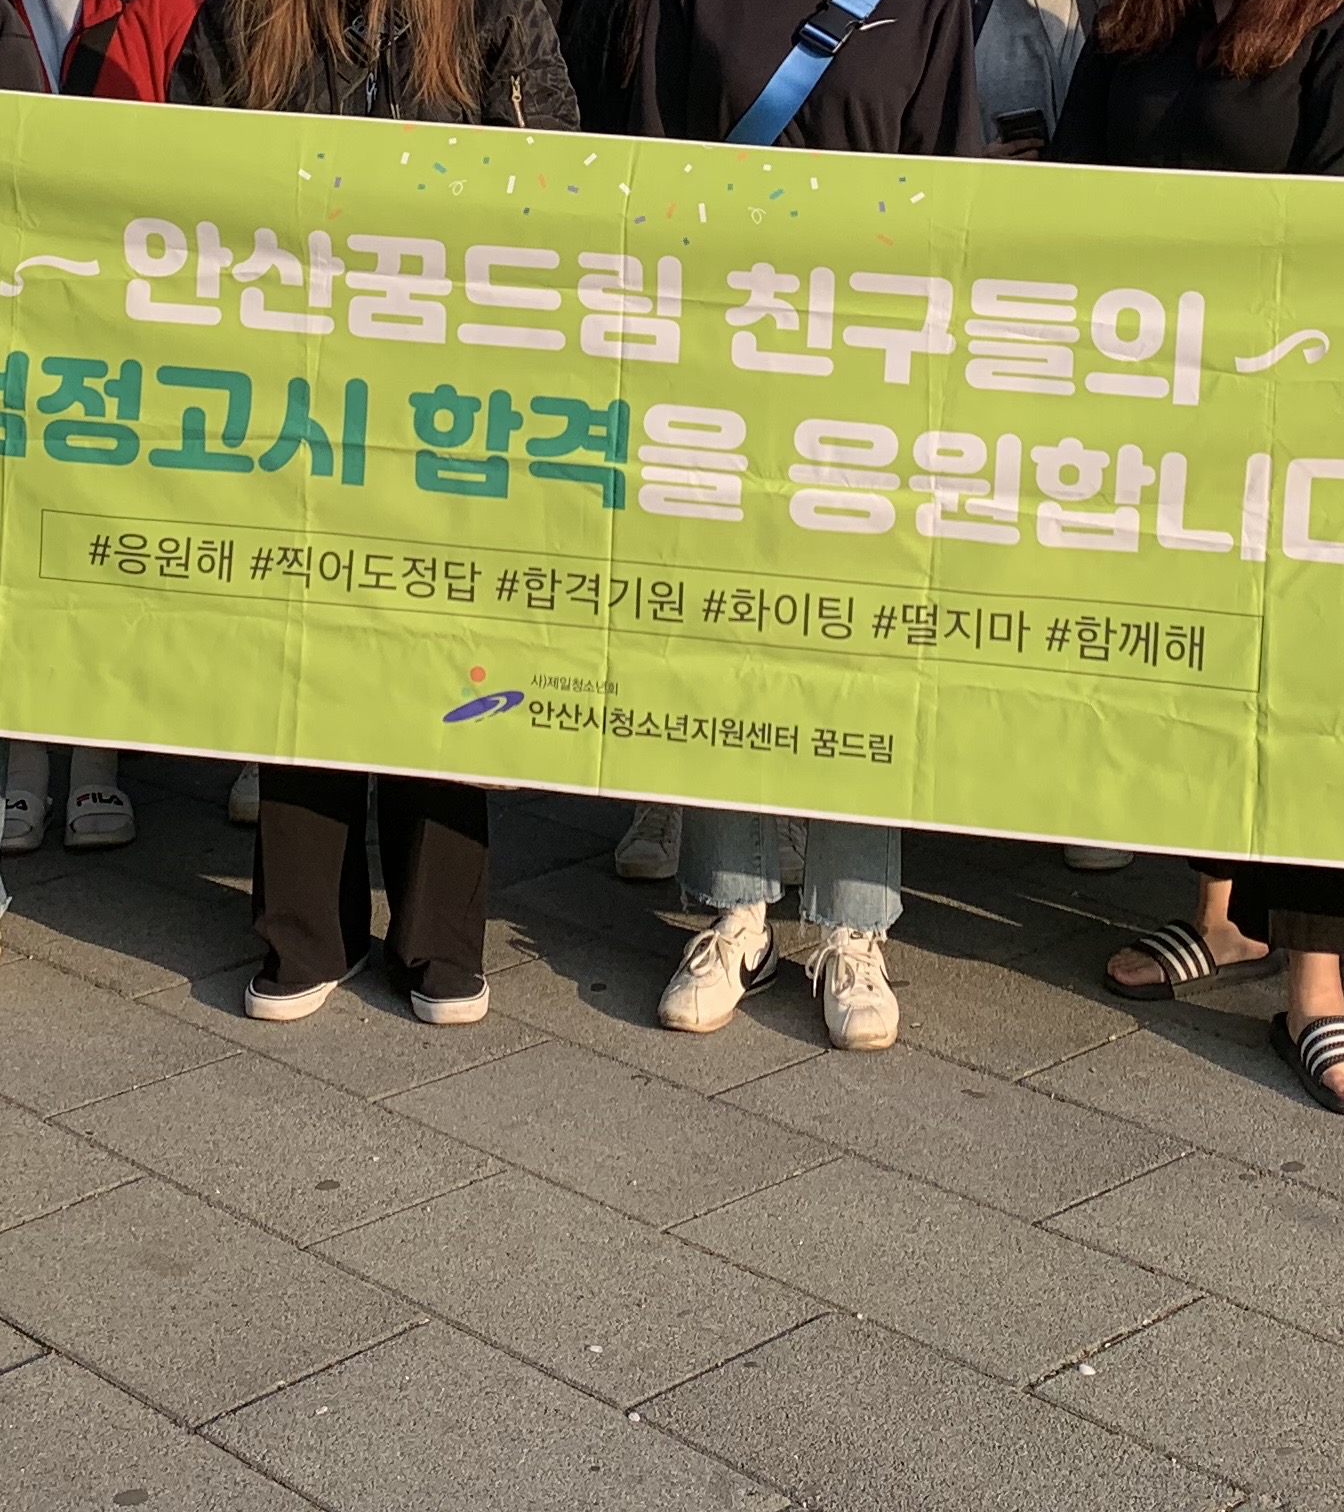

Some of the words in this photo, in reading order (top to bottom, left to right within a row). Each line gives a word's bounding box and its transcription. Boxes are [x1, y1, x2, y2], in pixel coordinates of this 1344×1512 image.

[124, 217, 682, 364] 안산꿈드림
[725, 262, 1205, 406] 친구들의
[409, 384, 749, 522] 합격을
[88, 533, 234, 583] #응원해
[250, 545, 482, 603] #찍어도정답
[496, 567, 684, 623] #합격기원
[702, 587, 854, 640] #화이팅
[871, 604, 1031, 653] #떨지마
[1045, 616, 1205, 671] #함께해
[76, 792, 124, 807] FILA
[528, 700, 799, 755] 안산시청소년지원센터
[811, 728, 894, 764] 꿈드림
